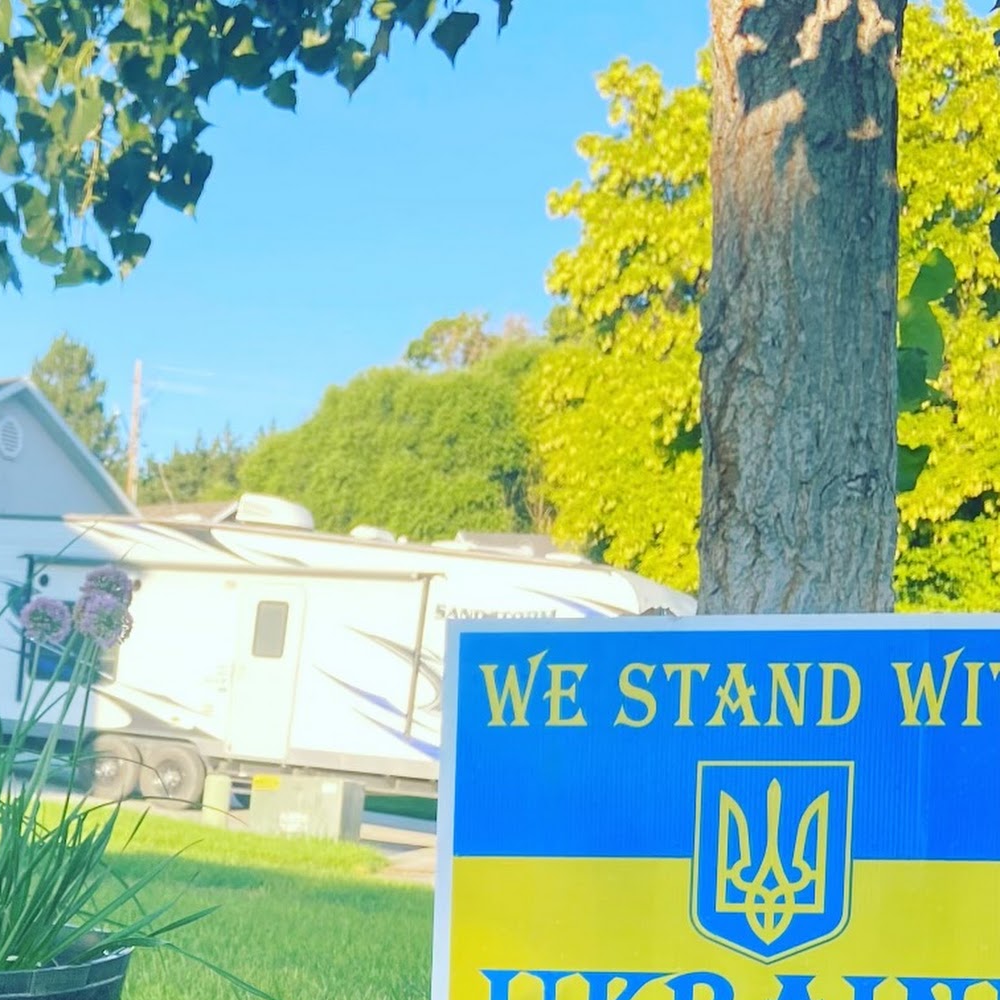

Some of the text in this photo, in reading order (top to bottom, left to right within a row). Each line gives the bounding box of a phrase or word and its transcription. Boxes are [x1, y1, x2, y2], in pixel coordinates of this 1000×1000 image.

[478, 646, 1000, 728] WE STAND WI
